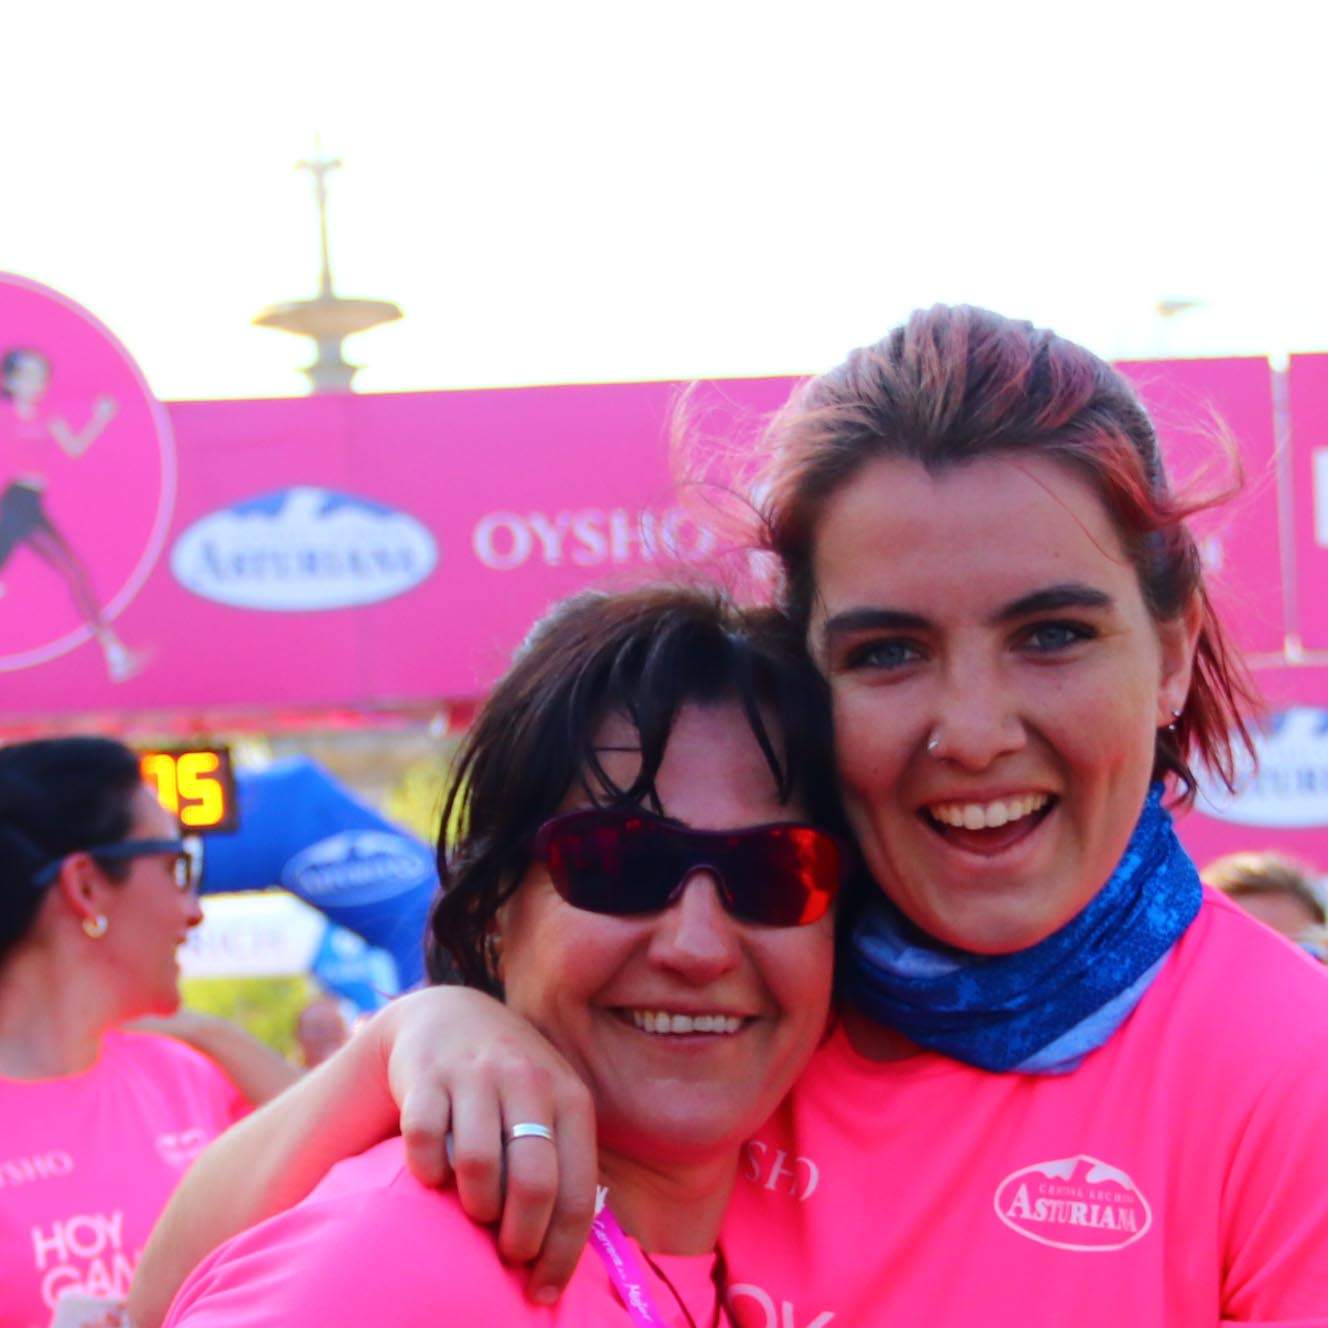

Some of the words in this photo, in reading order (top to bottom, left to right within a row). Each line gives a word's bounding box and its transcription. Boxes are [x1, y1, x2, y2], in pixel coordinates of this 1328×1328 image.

[473, 510, 715, 570] OYSHO
[1006, 1182, 1138, 1233] ASTURIANA
[32, 1211, 124, 1270] HOY
[41, 1250, 142, 1309] GAN
